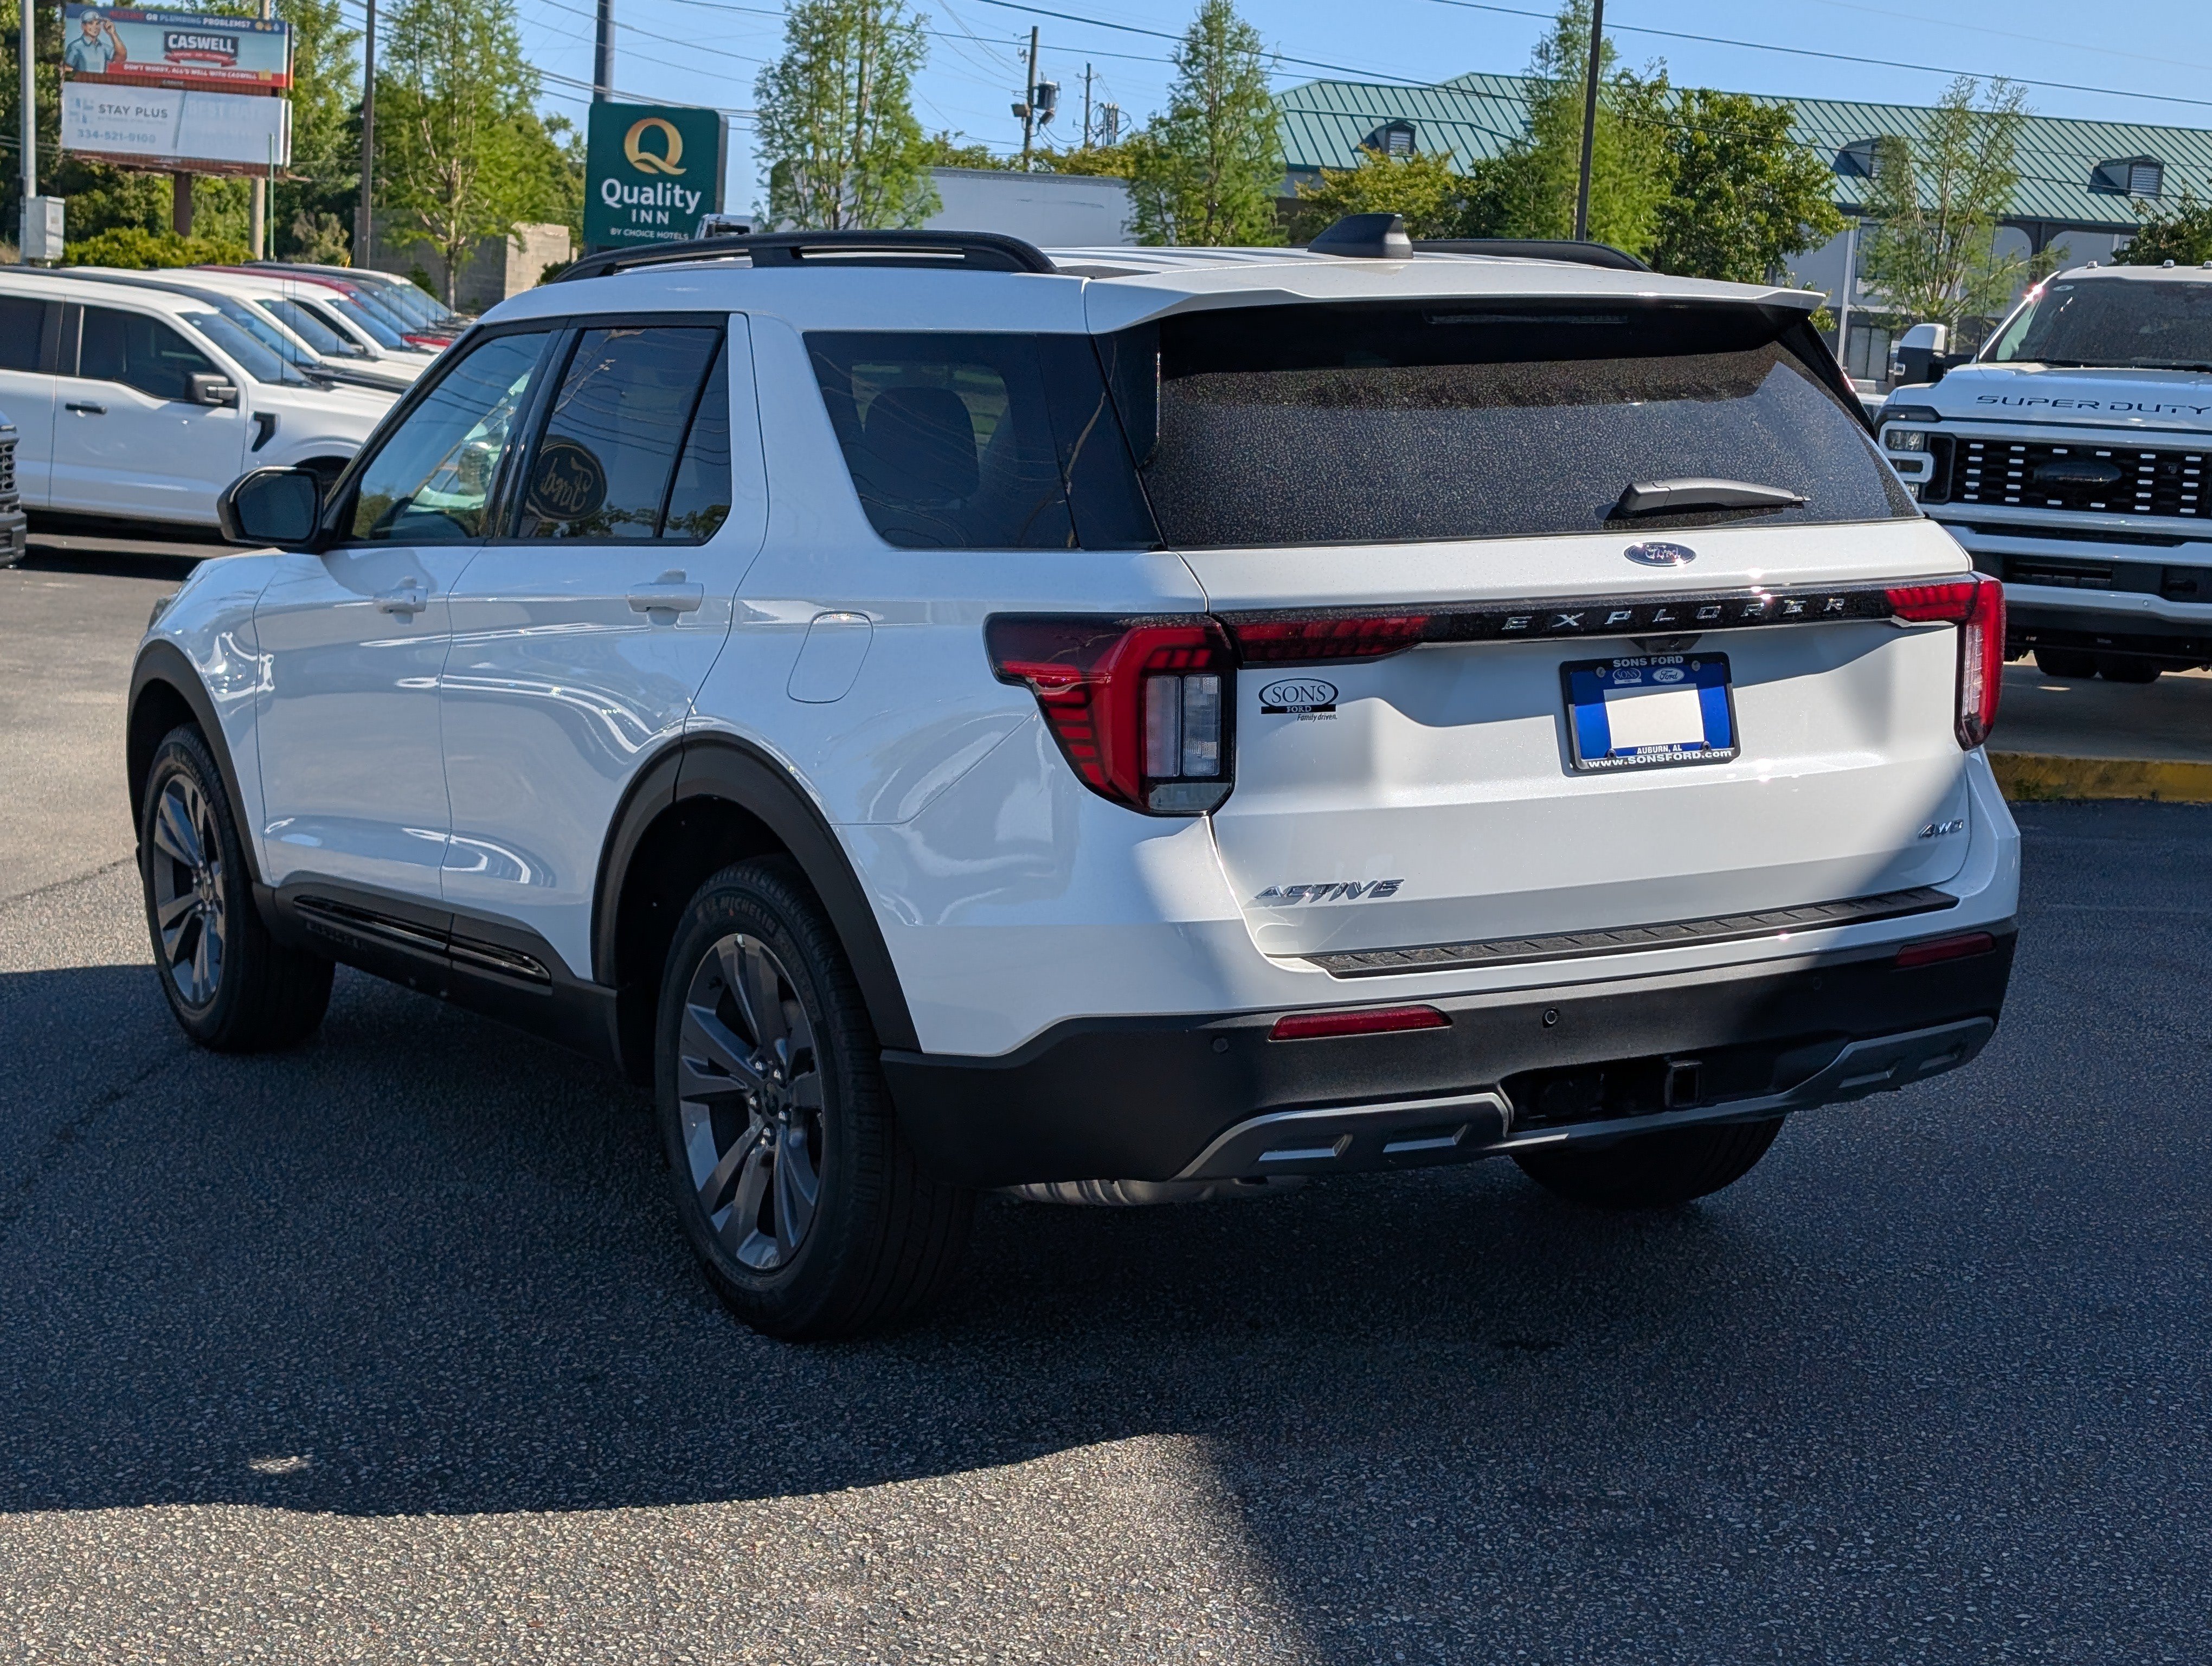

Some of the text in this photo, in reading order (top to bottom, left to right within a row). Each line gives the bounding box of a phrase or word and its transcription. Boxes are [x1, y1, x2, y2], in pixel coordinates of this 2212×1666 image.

[203, 17, 250, 28] PROBLEMS?
[168, 34, 235, 53] CASWELL
[99, 104, 168, 119] STAY PLUS
[601, 178, 702, 214] Quality
[631, 208, 670, 225] INN
[609, 227, 689, 240] BY CHOICE HOTELS
[1976, 395, 2211, 414] SUPER DUTY
[1501, 598, 1845, 630] EXPLORER
[1613, 656, 1684, 668] SONS FORD
[1660, 670, 1678, 680] Ford
[1271, 685, 1326, 703] SONS
[1297, 714, 1317, 722] Family
[1637, 745, 1671, 754] AUBURN,
[1589, 749, 1732, 768] www.SONSFORD.com
[1918, 818, 1964, 838] 4WD
[1253, 879, 1404, 900] ACTIVE
